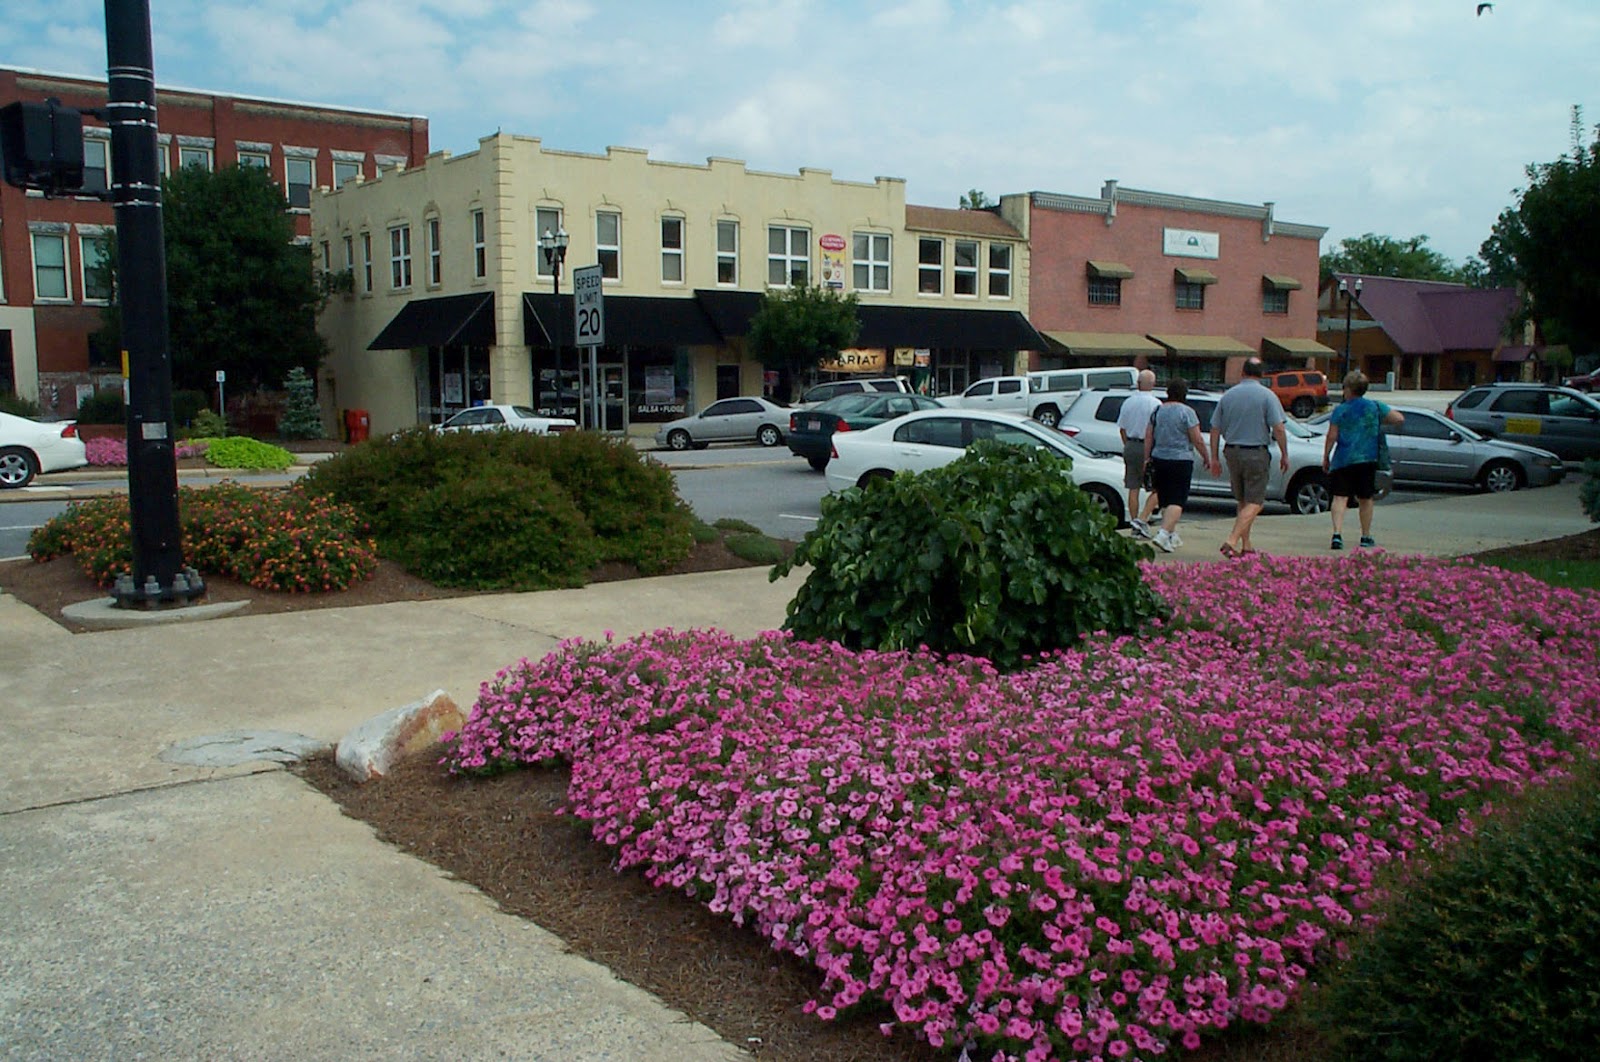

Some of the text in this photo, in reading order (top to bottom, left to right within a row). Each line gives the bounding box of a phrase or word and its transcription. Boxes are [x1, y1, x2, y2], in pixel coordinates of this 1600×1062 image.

[576, 275, 599, 290] SPEED
[579, 291, 598, 305] LIMIT
[579, 308, 600, 336] 20
[838, 354, 879, 367] ARIAT
[638, 405, 685, 413] SALSA FUDGE
